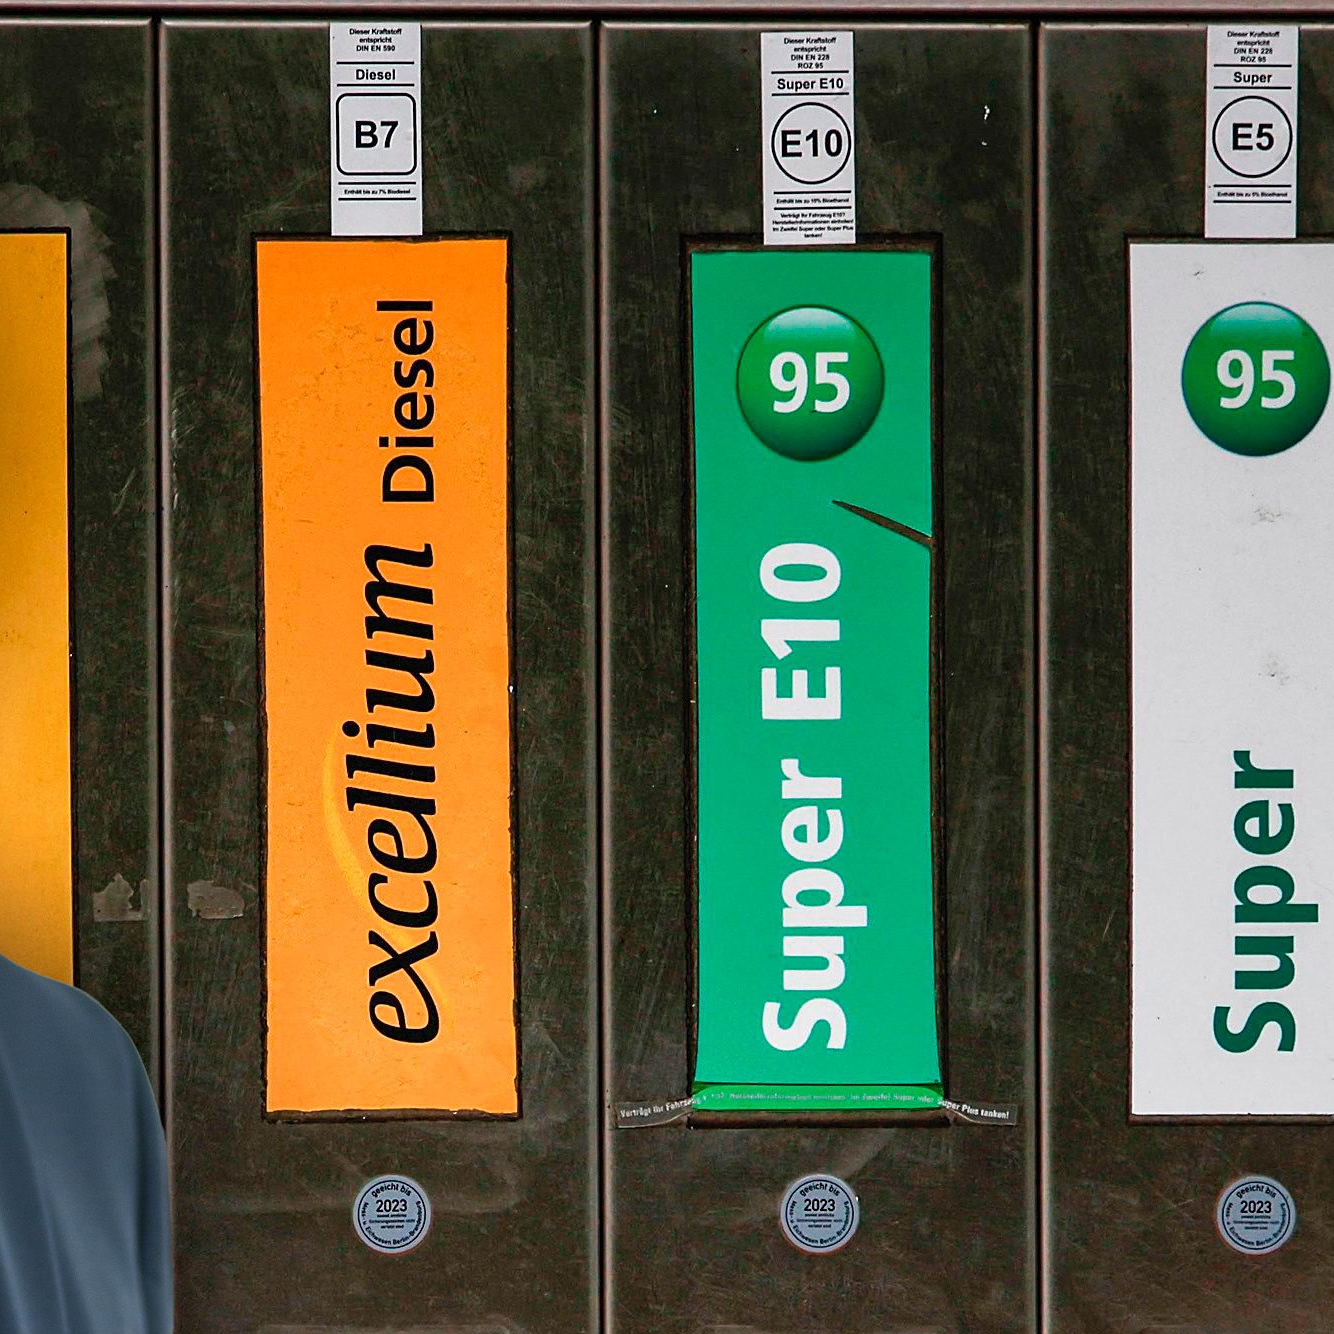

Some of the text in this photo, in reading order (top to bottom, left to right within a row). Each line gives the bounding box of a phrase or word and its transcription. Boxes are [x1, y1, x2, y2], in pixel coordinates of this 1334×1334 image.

[356, 69, 395, 80] Diesel
[1234, 72, 1272, 85] Super
[778, 78, 843, 92] Super E10
[356, 121, 398, 148] B7
[1233, 123, 1274, 150] E5
[782, 129, 842, 157] E10
[770, 352, 849, 412] 95
[1217, 350, 1295, 408] 95
[760, 543, 841, 720] E10
[342, 301, 439, 1043] excellium Diesel
[763, 759, 867, 1050] Super
[1213, 750, 1318, 1053] Super
[961, 1104, 979, 1116] Plus
[980, 1109, 1009, 1119] tanken!
[371, 1183, 412, 1198] geeicht bis
[799, 1183, 841, 1197] geeicht bis
[1236, 1184, 1277, 1199] geeicht bis
[376, 1199, 407, 1212] 2023
[804, 1199, 835, 1211] 2023
[1240, 1200, 1271, 1213] 2023
